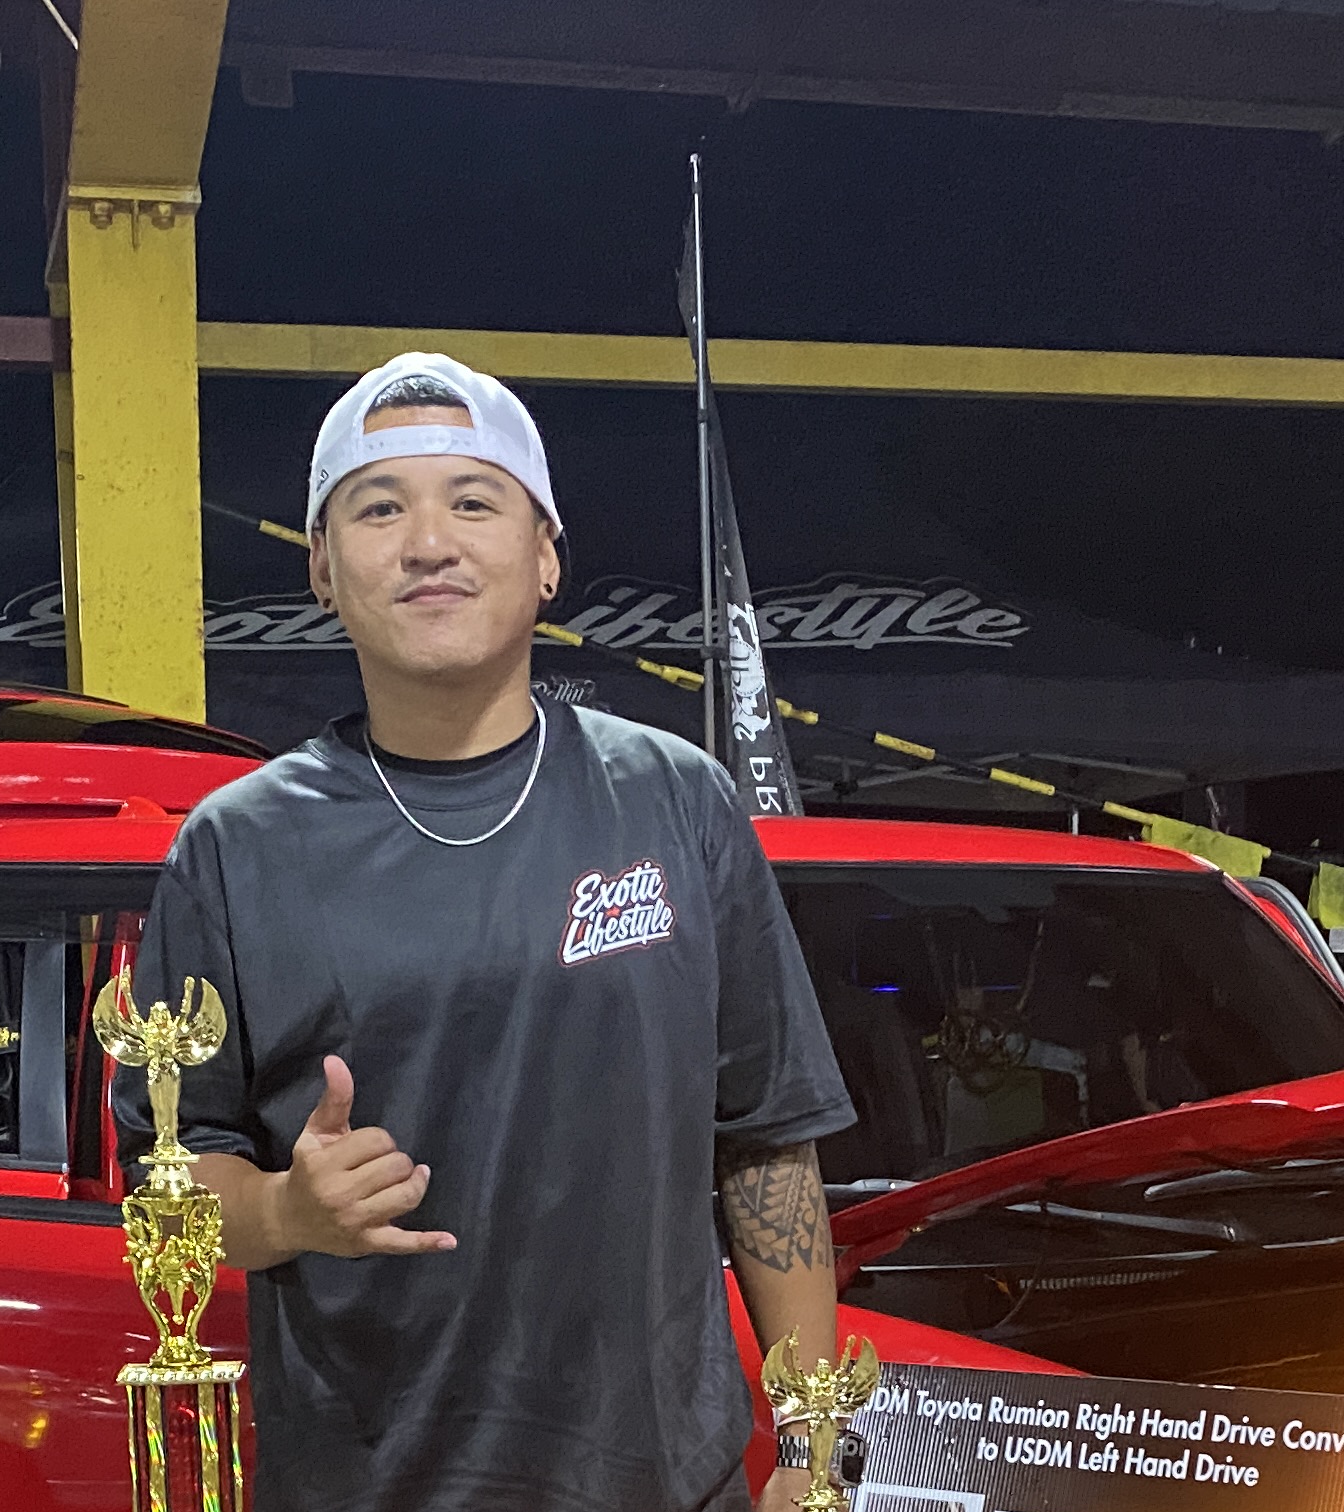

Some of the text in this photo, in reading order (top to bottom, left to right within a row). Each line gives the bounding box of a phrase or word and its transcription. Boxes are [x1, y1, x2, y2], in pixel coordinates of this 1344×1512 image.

[572, 861, 665, 918] Exotic
[563, 899, 674, 963] Lifestyle
[916, 1390, 983, 1426] Toyota
[988, 1396, 1069, 1429] Rumion
[1075, 1402, 1135, 1440] Right
[1139, 1408, 1207, 1441] Hand
[1211, 1414, 1276, 1447] Drive
[977, 1436, 1260, 1487] to USDM Left Hand Drive
